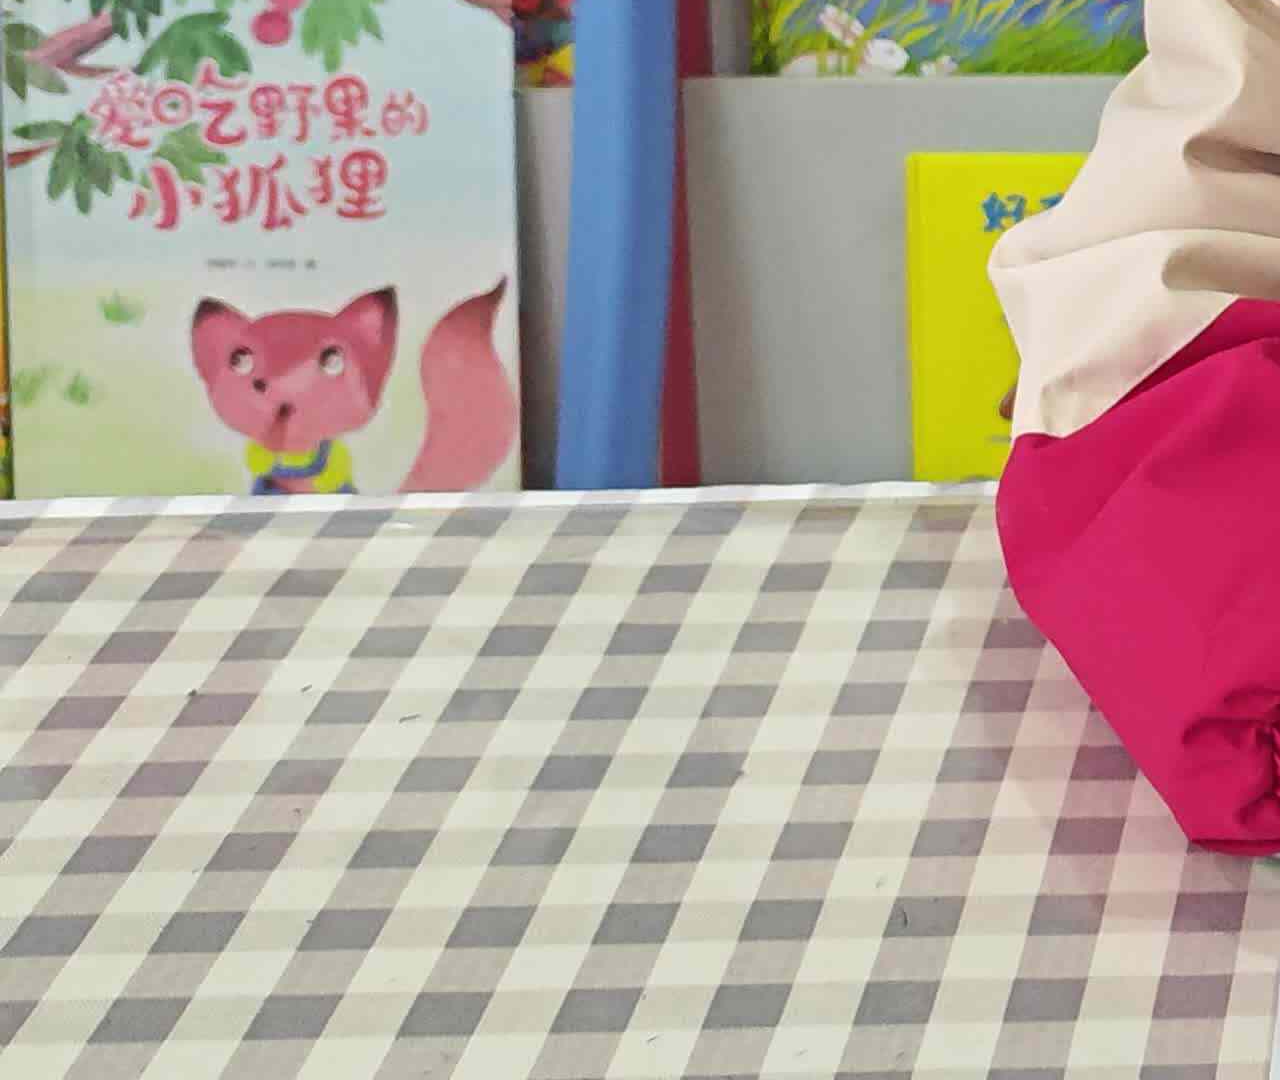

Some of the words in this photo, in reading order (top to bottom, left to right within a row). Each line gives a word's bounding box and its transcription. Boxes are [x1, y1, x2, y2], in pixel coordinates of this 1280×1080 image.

[87, 58, 430, 149] 爱吃野果的
[126, 149, 391, 231] 小狐狸
